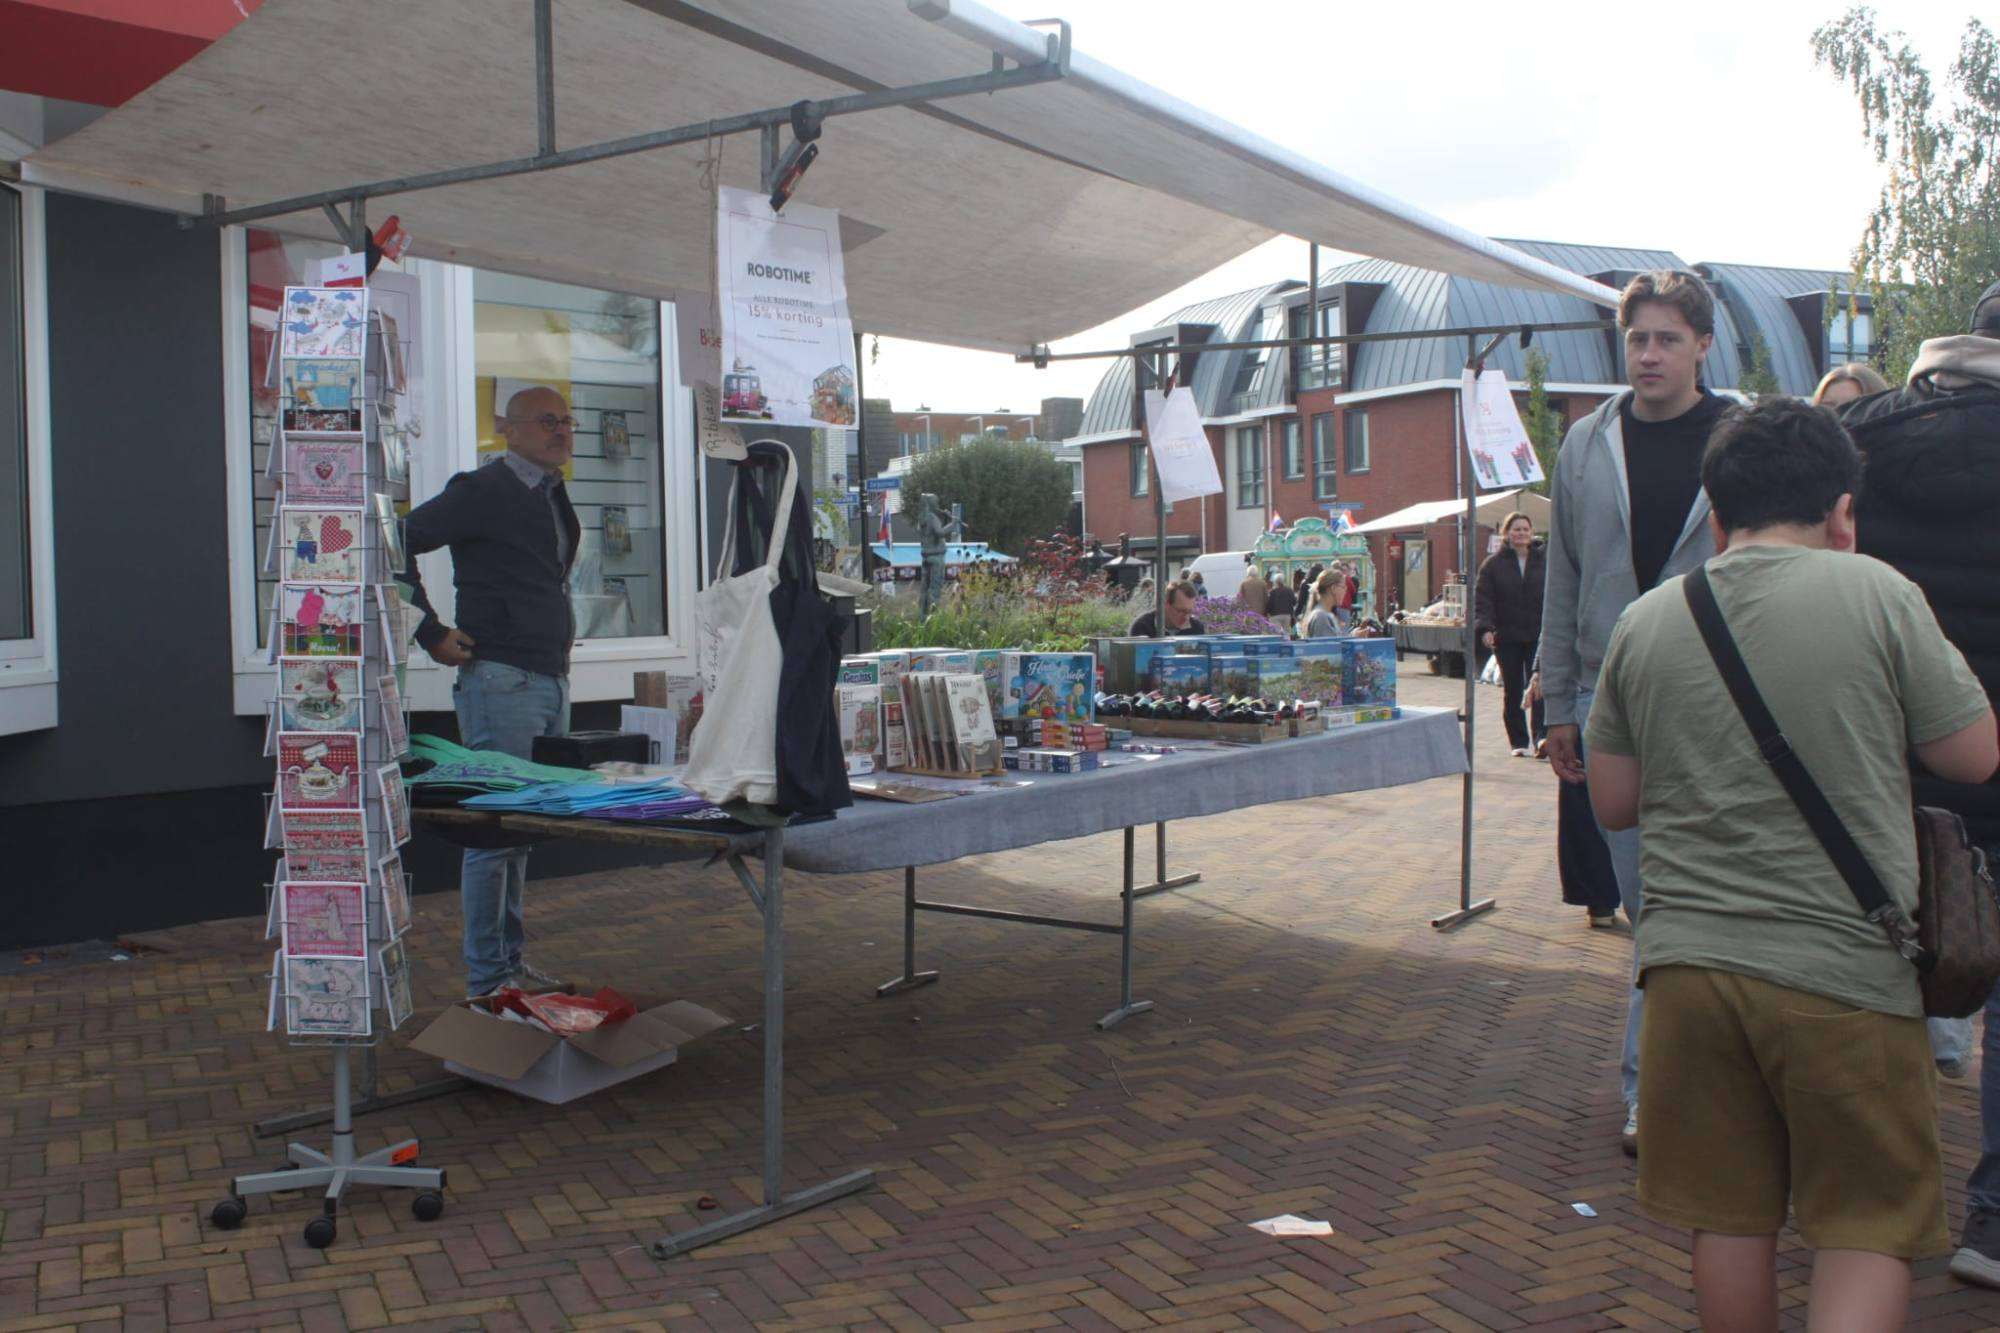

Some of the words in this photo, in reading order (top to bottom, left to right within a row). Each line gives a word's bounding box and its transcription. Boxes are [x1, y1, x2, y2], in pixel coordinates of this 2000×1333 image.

[747, 262, 812, 285] ROBOTIME
[749, 304, 772, 319] 15%
[776, 307, 824, 328] korting
